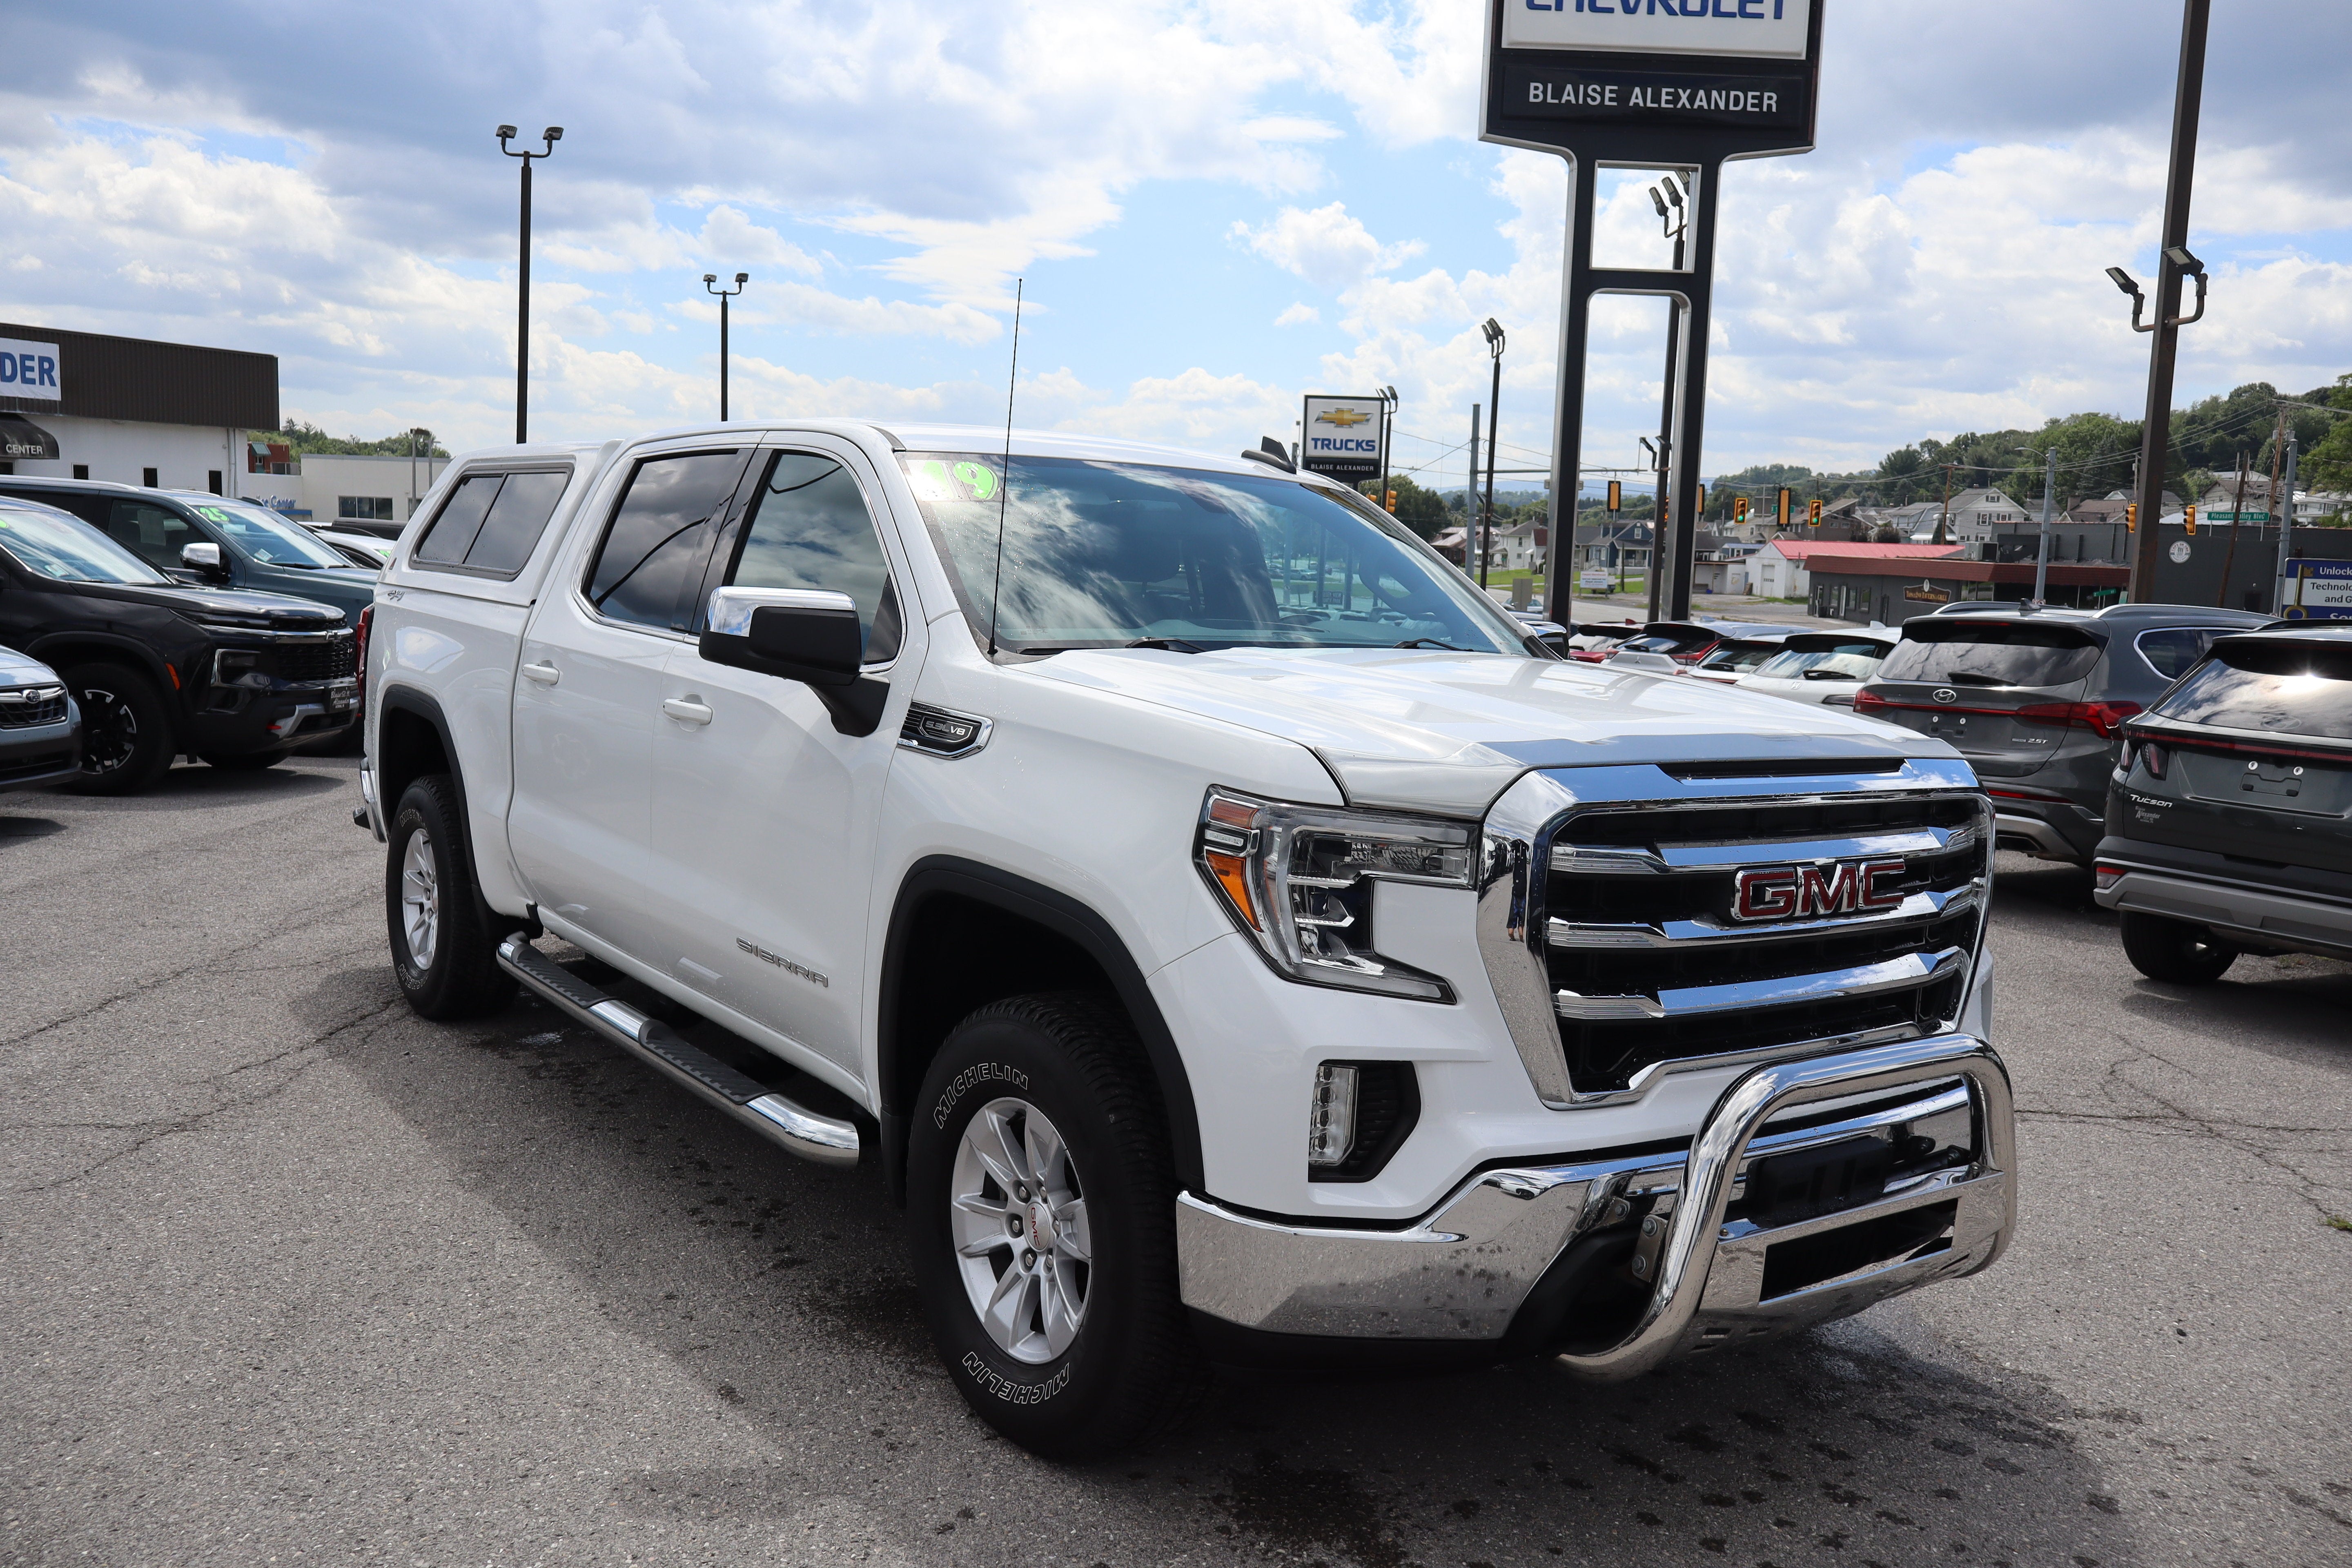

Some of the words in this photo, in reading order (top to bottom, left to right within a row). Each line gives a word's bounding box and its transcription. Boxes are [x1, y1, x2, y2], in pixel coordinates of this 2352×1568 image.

[1526, 0, 1783, 19] ROLET
[1529, 82, 1619, 106] BLAISE
[1629, 87, 1777, 113] ALEXANDER
[6, 444, 43, 454] CENTER
[1311, 438, 1376, 452] TRUCKS
[200, 507, 229, 521] 25
[269, 495, 296, 508] Center
[2320, 567, 2352, 575] Unlock
[1730, 858, 1906, 921] GMC
[736, 936, 828, 987] SIERRA
[933, 1063, 1028, 1129] MICHELIN
[1031, 1207, 1040, 1245] GMC
[962, 1352, 1069, 1404] MICHELIN
